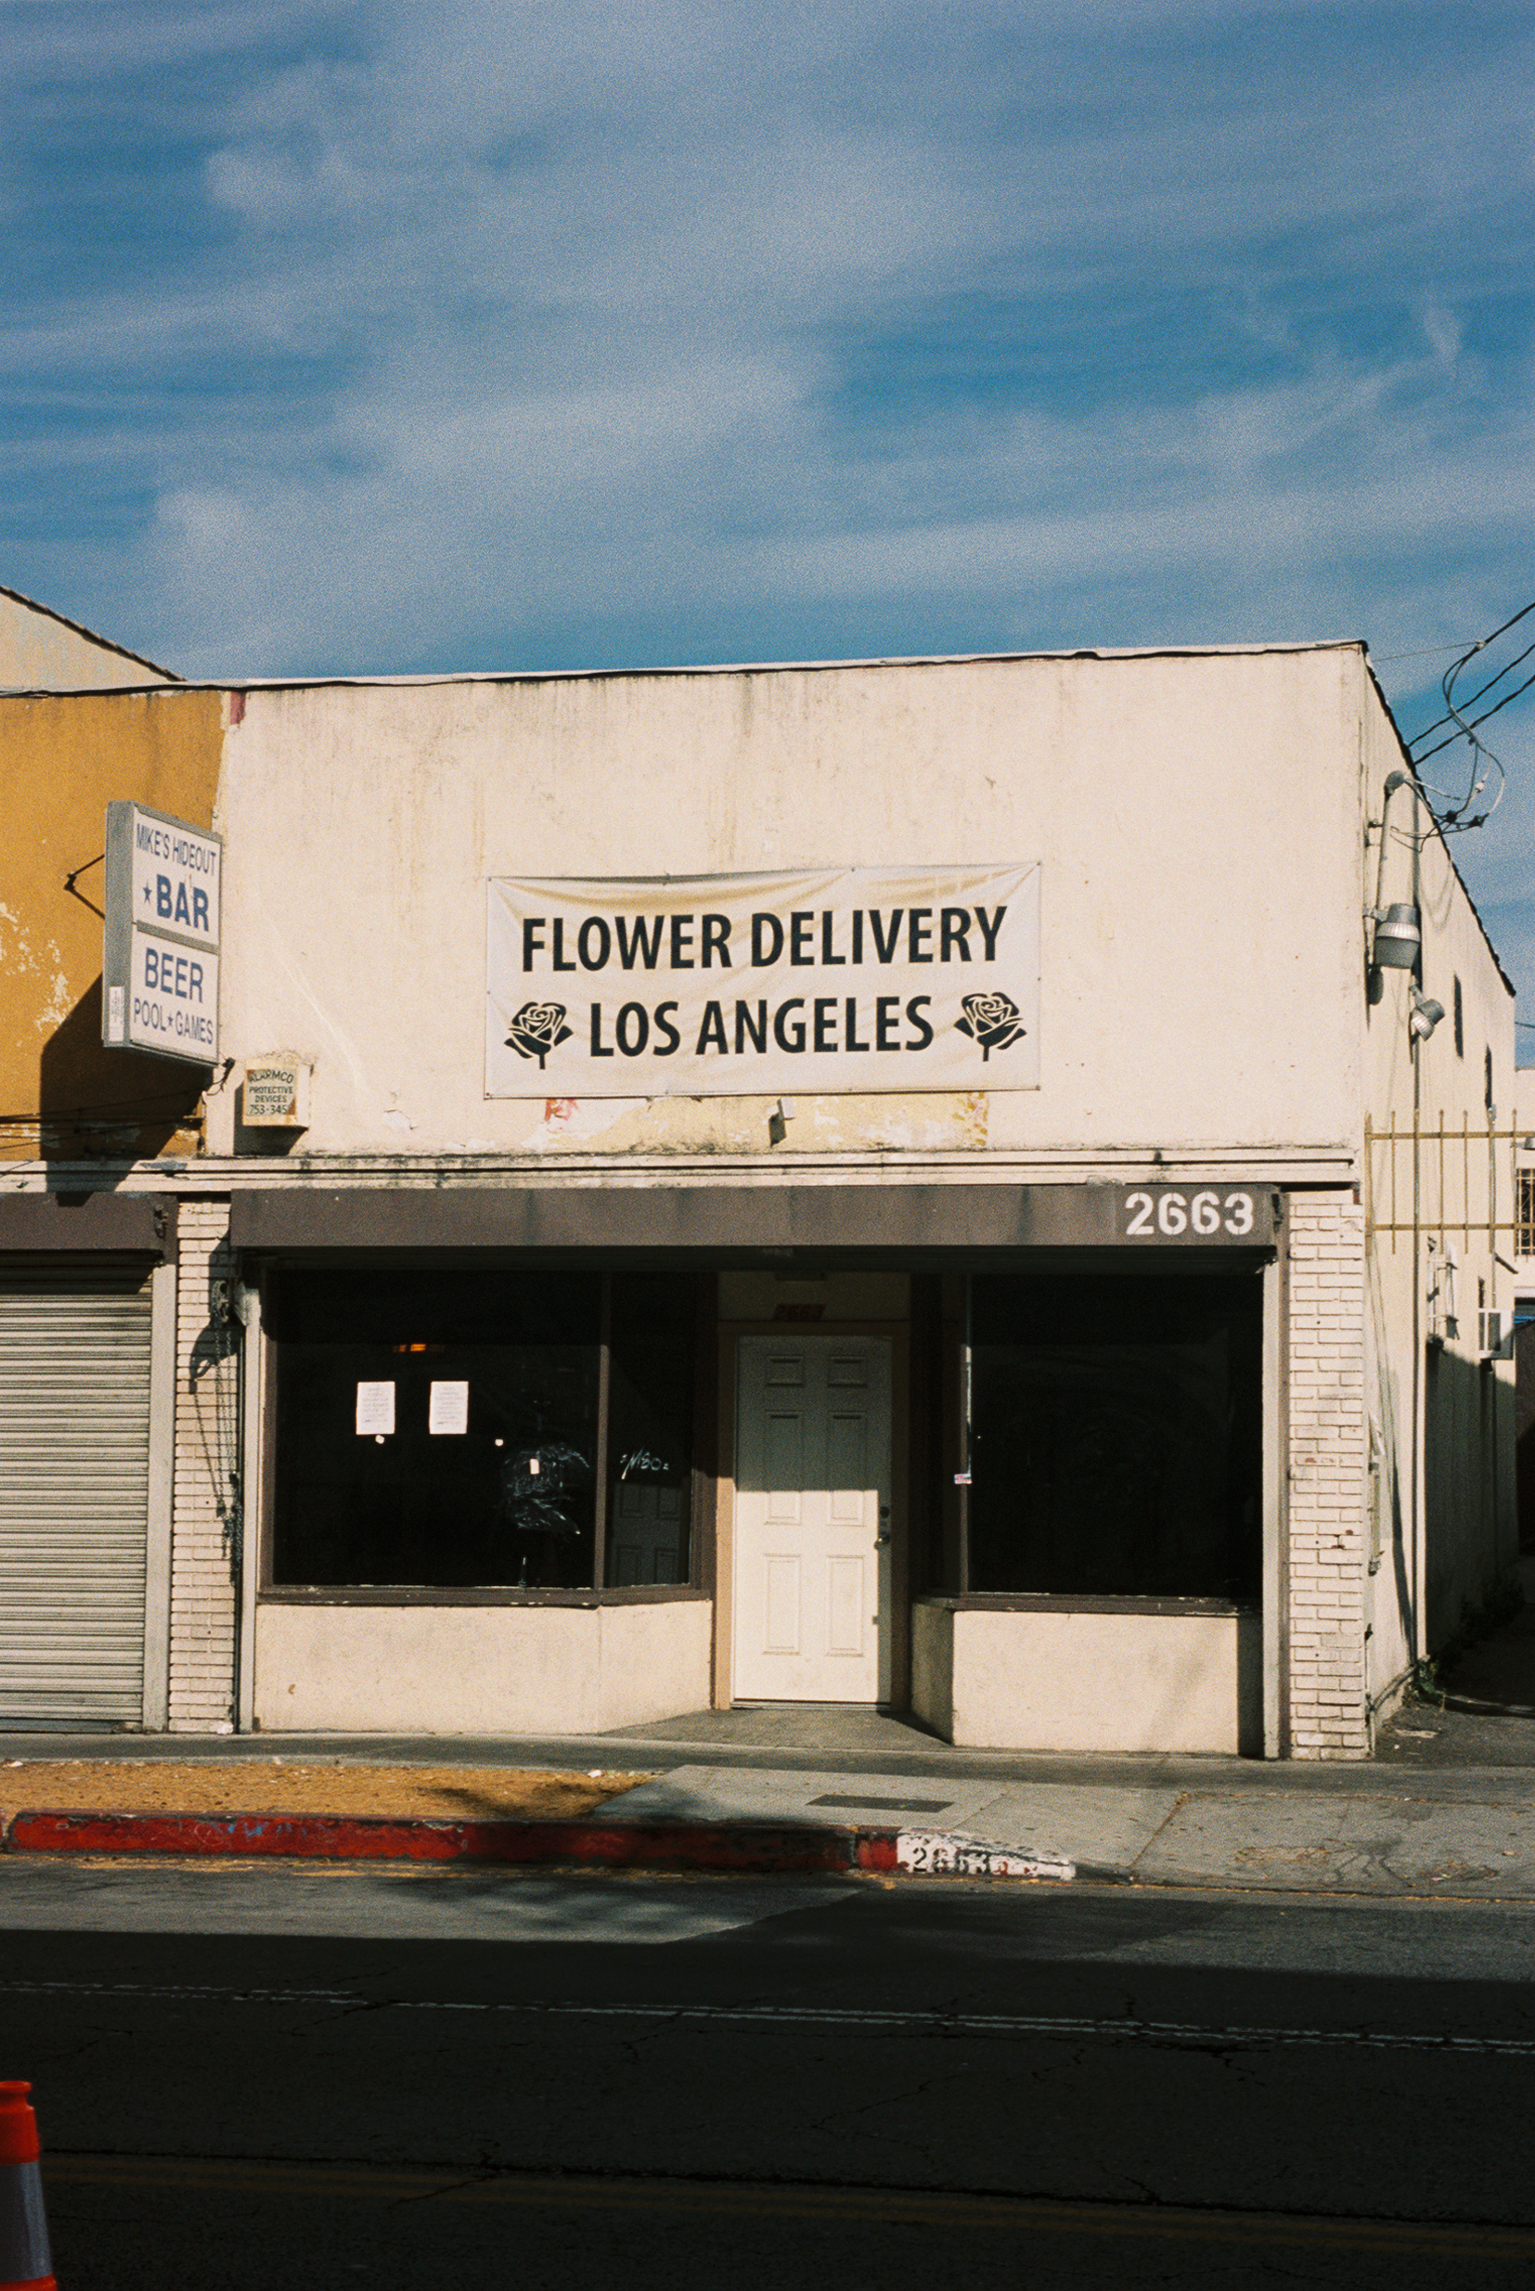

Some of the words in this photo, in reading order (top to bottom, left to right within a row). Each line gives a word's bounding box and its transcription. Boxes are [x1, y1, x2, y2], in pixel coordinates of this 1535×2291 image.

[172, 837, 216, 876] HIDEOUT
[156, 874, 209, 932] BAR
[522, 913, 733, 972] FLOWER
[751, 906, 1008, 968] DELIVERY
[145, 947, 203, 1003] BEER
[133, 997, 167, 1031] POOL
[175, 1010, 214, 1045] GAMES
[590, 1000, 681, 1057] LOS
[695, 995, 934, 1056] ANGELES
[249, 1086, 293, 1094] PROTECTIVE
[255, 1095, 287, 1103] DEVICES
[1125, 1191, 1254, 1235] 2663
